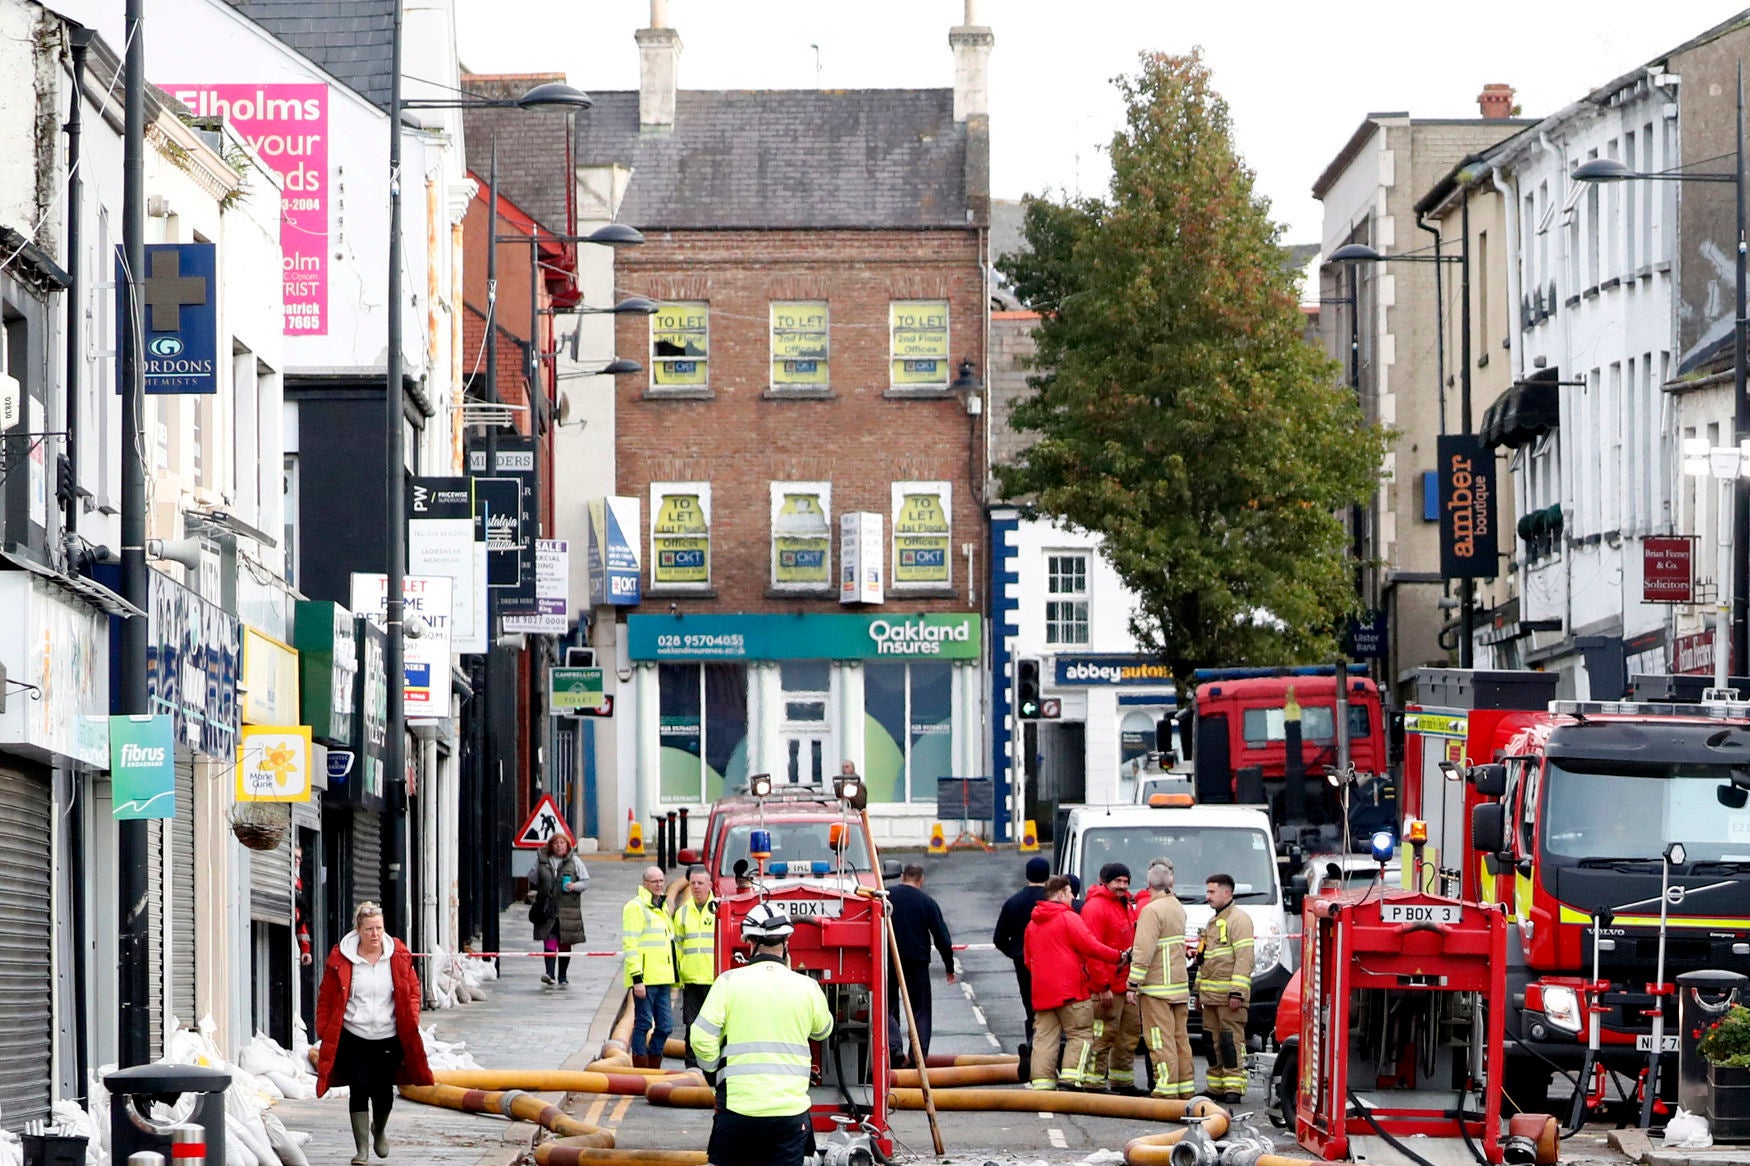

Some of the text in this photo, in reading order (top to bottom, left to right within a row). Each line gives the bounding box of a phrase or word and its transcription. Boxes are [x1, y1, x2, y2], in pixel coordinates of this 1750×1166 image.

[175, 90, 321, 121] Elholms
[657, 316, 703, 328] TO LET
[778, 316, 824, 328] TO LET
[896, 315, 944, 326] TO LET
[470, 456, 531, 467] MIDERS
[413, 486, 428, 512] PW
[671, 498, 690, 509] TO
[911, 498, 931, 508] TO
[1448, 454, 1487, 558] amber boutique
[668, 511, 693, 522] LET
[908, 510, 934, 521] LET
[536, 542, 562, 551] SALE
[677, 551, 699, 562] OKT
[916, 551, 942, 562] OKT
[1645, 549, 1689, 560] Brian Feeney
[1656, 561, 1678, 569] & Co.
[379, 579, 389, 590] T
[621, 577, 637, 591] OKT
[1644, 579, 1689, 589] Solicitors
[380, 597, 424, 611] PME
[418, 615, 447, 628] NIT
[523, 616, 543, 624] 9027
[545, 616, 566, 625] 0000
[869, 620, 969, 642] Oakland
[658, 635, 681, 647] 028
[1354, 634, 1380, 643] Ulster
[878, 640, 940, 654] Insures
[1356, 642, 1377, 651] Bank
[120, 744, 165, 768] fibrus
[250, 773, 273, 781] Marie
[252, 781, 273, 789] Curie
[790, 903, 818, 915] BOX
[1393, 908, 1451, 920] P BOX 3
